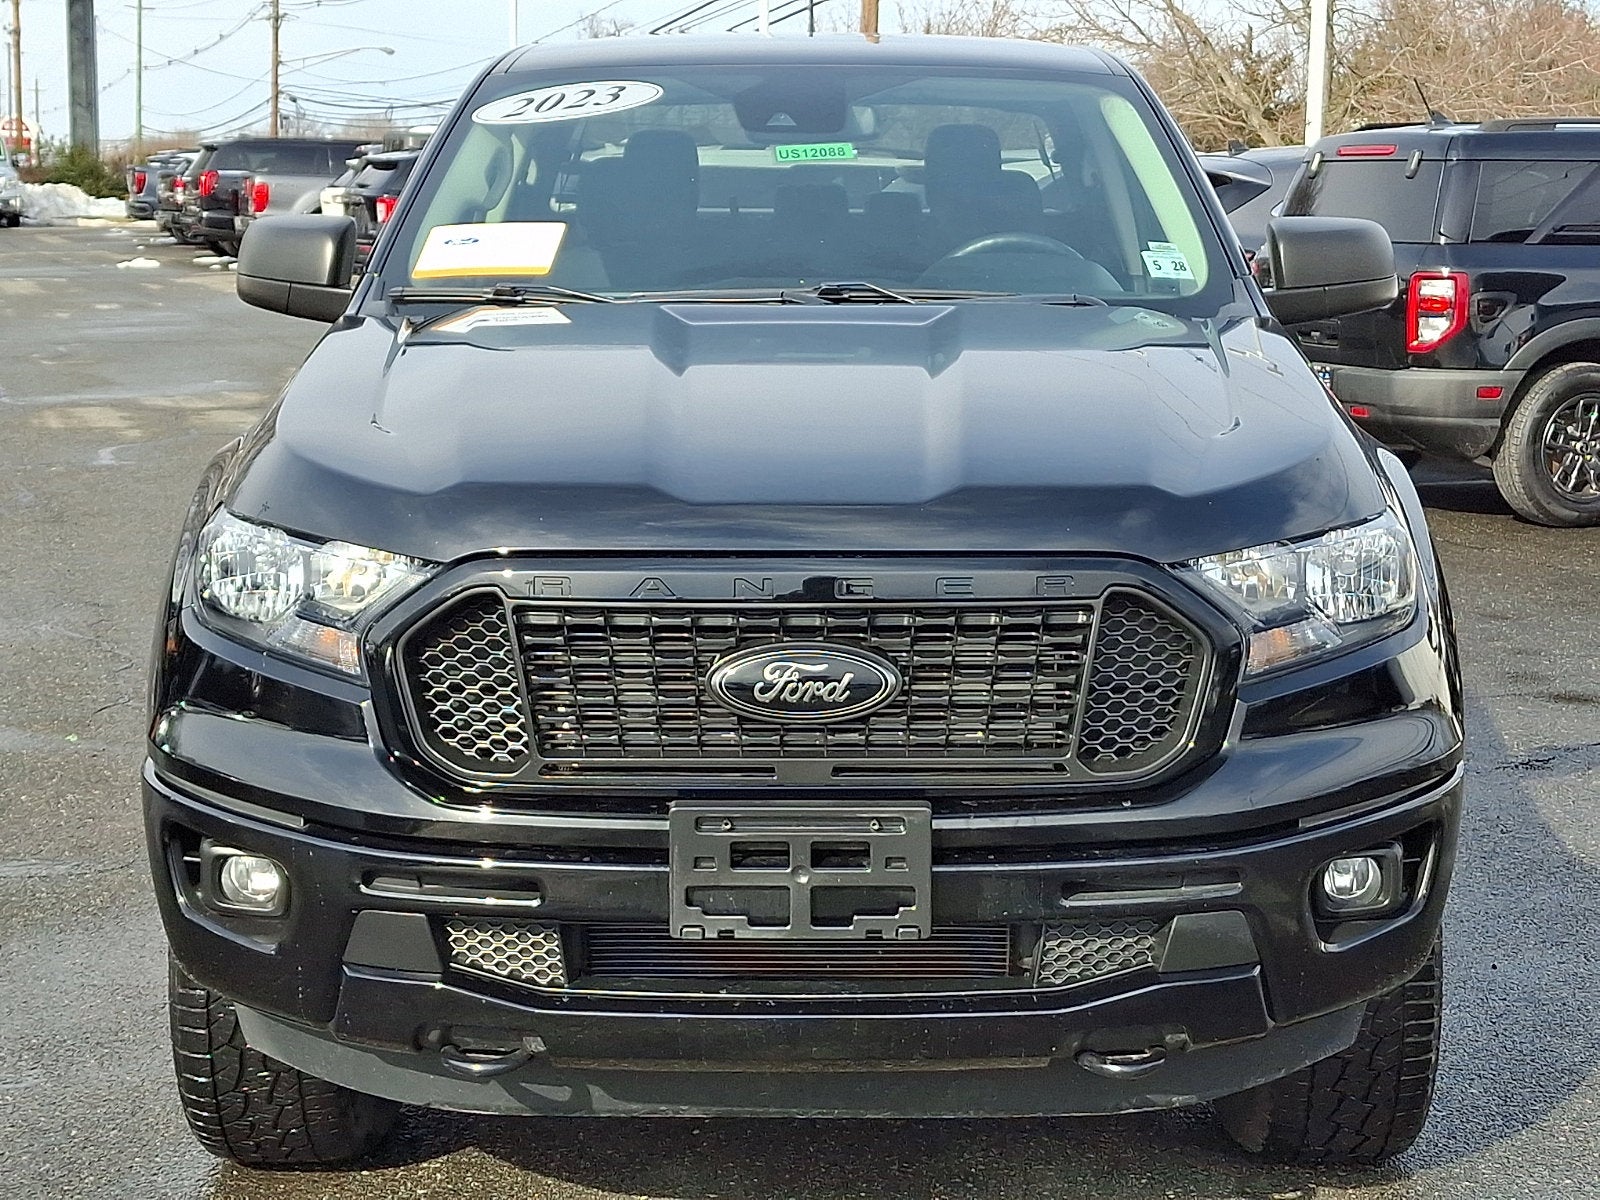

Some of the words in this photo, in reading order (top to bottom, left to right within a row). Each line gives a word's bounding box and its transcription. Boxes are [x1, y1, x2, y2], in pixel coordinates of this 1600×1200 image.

[500, 85, 627, 119] 2023
[778, 146, 847, 160] US12088
[1152, 260, 1162, 270] 5
[1171, 261, 1187, 271] 28
[531, 575, 1074, 598] RANGER
[754, 661, 854, 702] Ford
